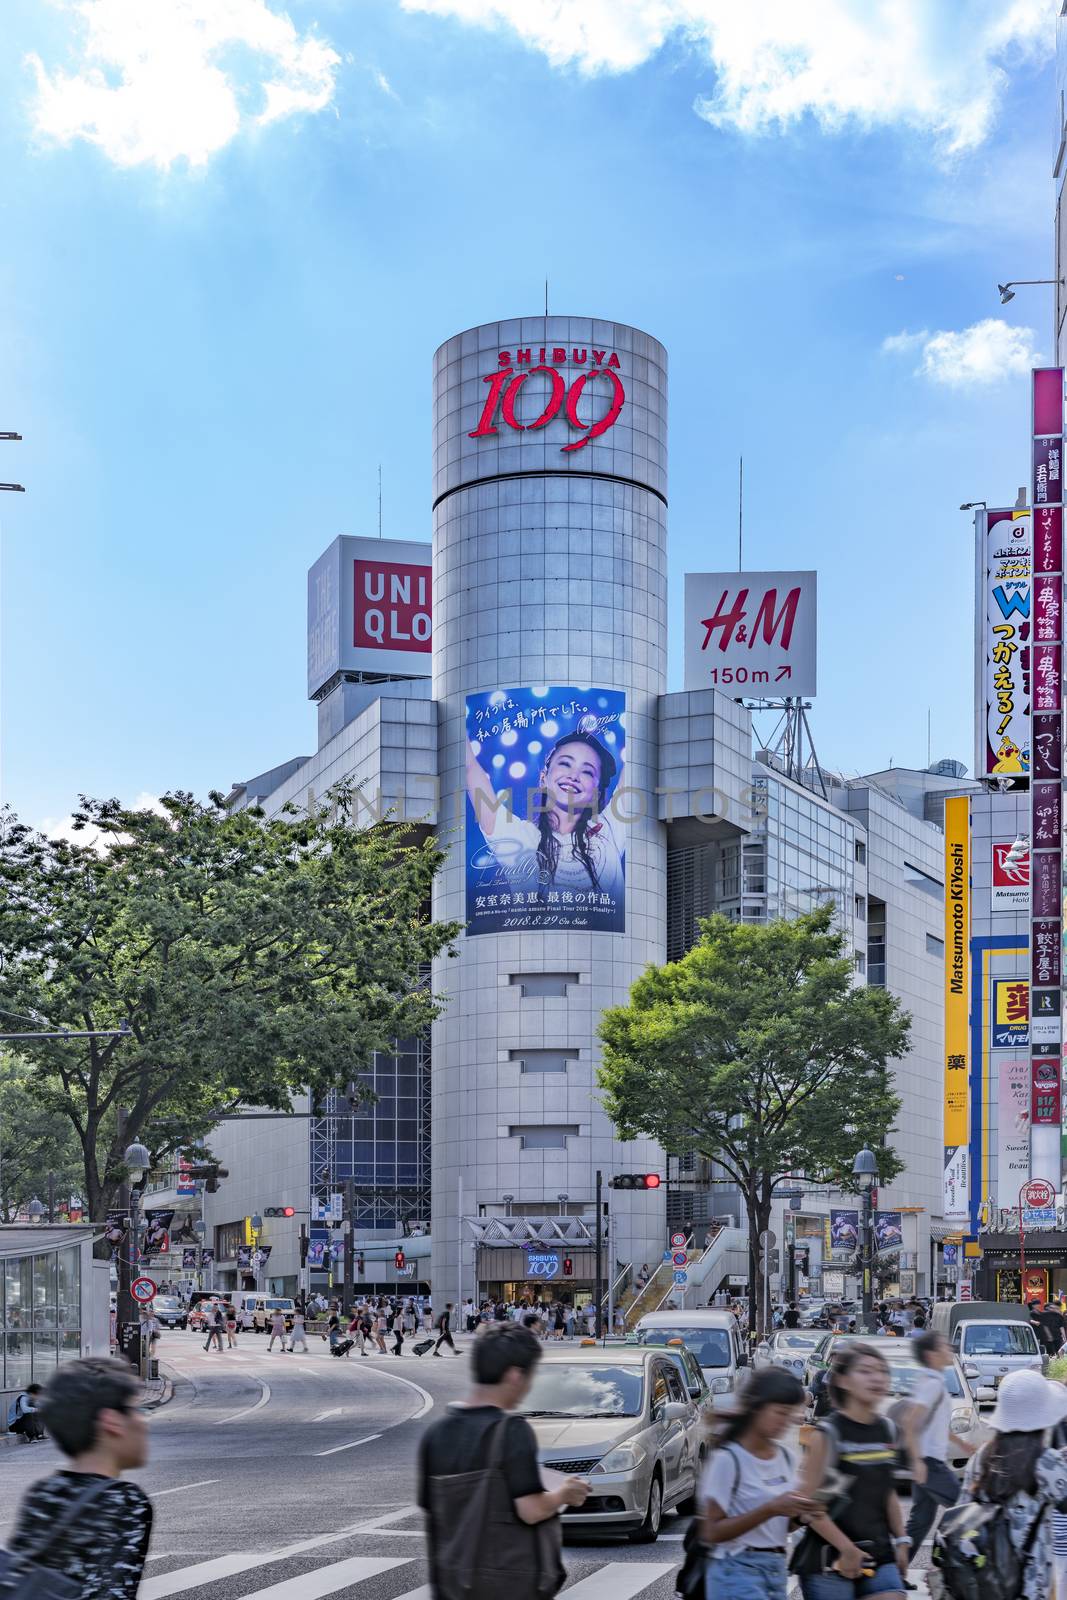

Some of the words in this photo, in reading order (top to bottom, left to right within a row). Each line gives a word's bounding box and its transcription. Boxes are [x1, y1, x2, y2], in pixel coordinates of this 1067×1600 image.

[498, 348, 621, 368] SHIBUYA
[467, 365, 626, 452] 109
[1036, 463, 1048, 503] 五右衛門
[1042, 508, 1055, 516] 8F
[364, 571, 426, 606] UNI
[1042, 577, 1054, 585] 7F
[700, 587, 801, 652] H&M
[1037, 587, 1060, 640] 串家物語
[364, 608, 432, 644] QLO
[1041, 646, 1053, 655] 7F
[1037, 656, 1060, 708] 串家物語
[1041, 715, 1053, 723] 6F
[1041, 786, 1053, 794] 6F
[1036, 805, 1053, 840] 卵と私
[475, 891, 616, 909] 安室奈美恵、最後の作品。
[503, 915, 559, 927] 2018.8.29
[558, 917, 570, 925] On
[571, 917, 589, 925] Sale
[1040, 921, 1053, 930] 6F
[950, 903, 964, 994] Matsumoto
[1035, 932, 1053, 981] 餃子屋台
[947, 1054, 966, 1071] 薬
[528, 1254, 558, 1262] SHIBUYA
[527, 1261, 559, 1279] 109
